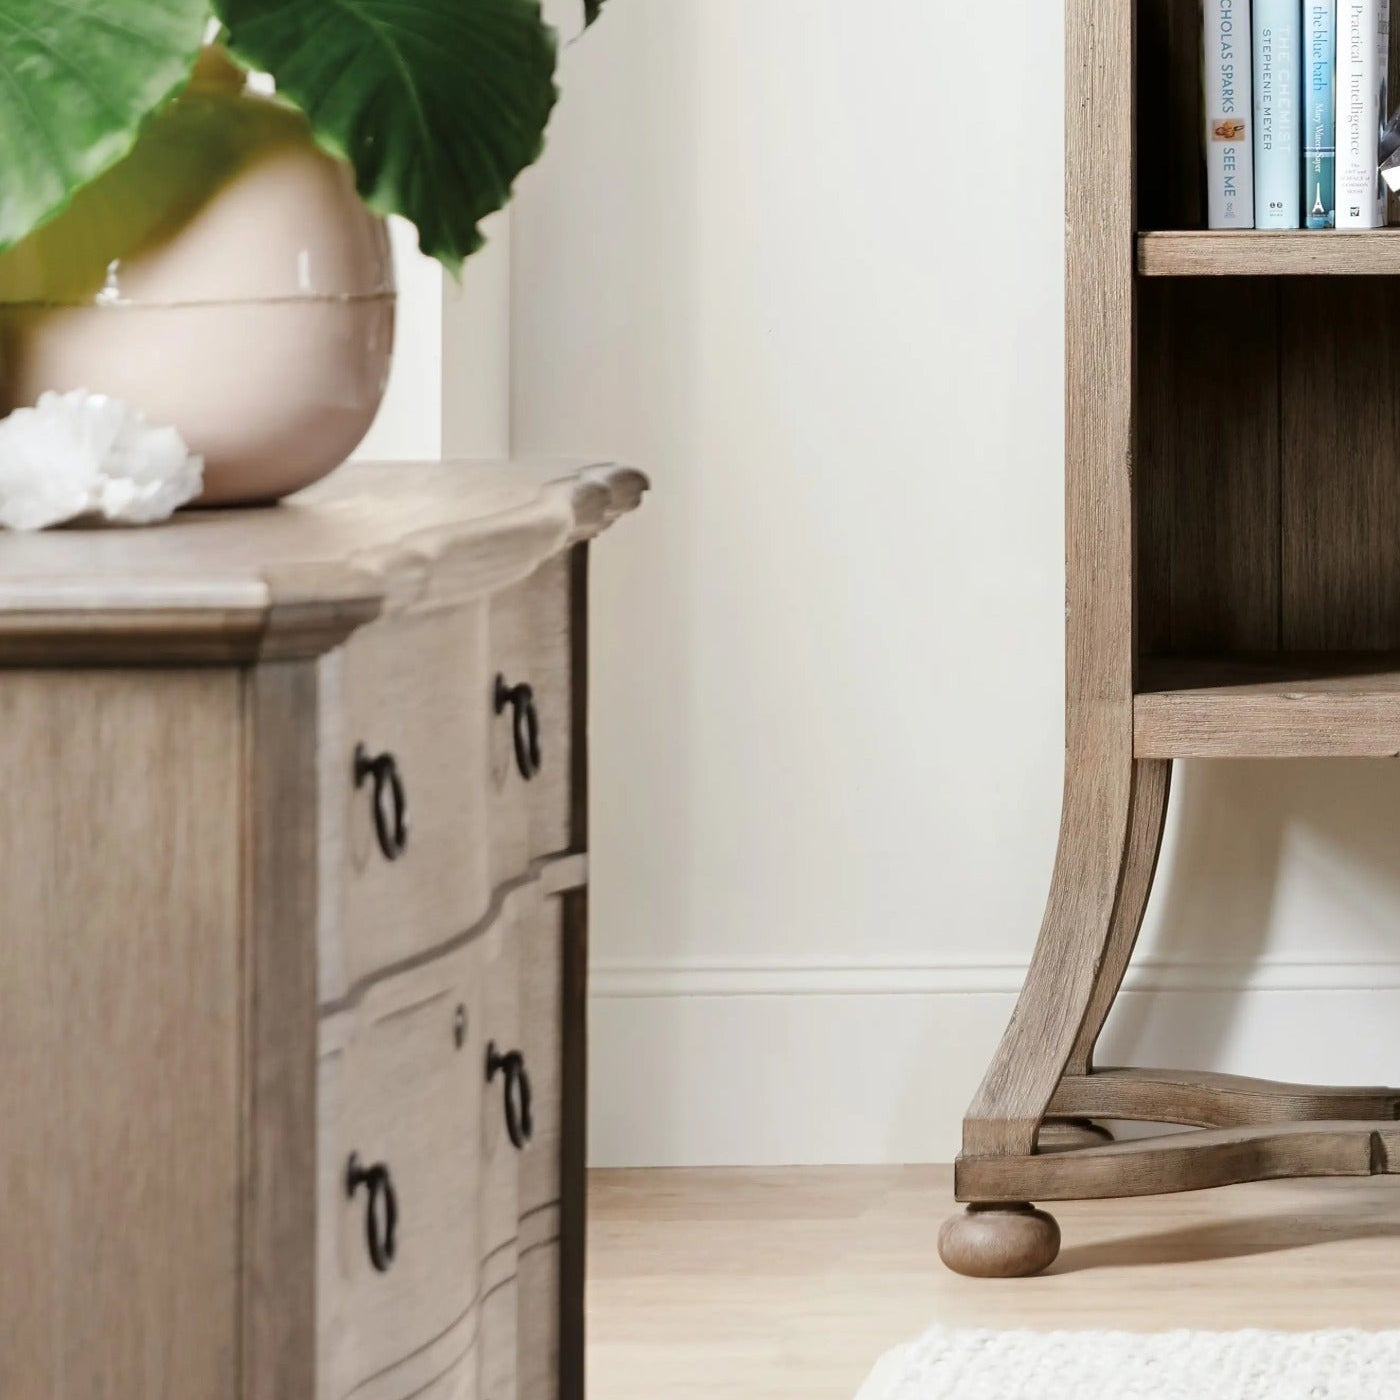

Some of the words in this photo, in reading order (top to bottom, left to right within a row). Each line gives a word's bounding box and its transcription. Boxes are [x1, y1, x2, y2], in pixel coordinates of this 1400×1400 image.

[1312, 6, 1328, 27] the
[1350, 5, 1363, 63] Practical
[1262, 28, 1272, 102] STEPHENIE
[1312, 30, 1328, 58] blue
[1221, 64, 1234, 113] SPARKS
[1312, 61, 1328, 91] bath
[1263, 107, 1272, 150] MEYER
[1279, 69, 1291, 153] CHEMIST
[1347, 74, 1363, 155] Intelligence
[1223, 147, 1235, 171] SEE
[1224, 176, 1236, 197] ME
